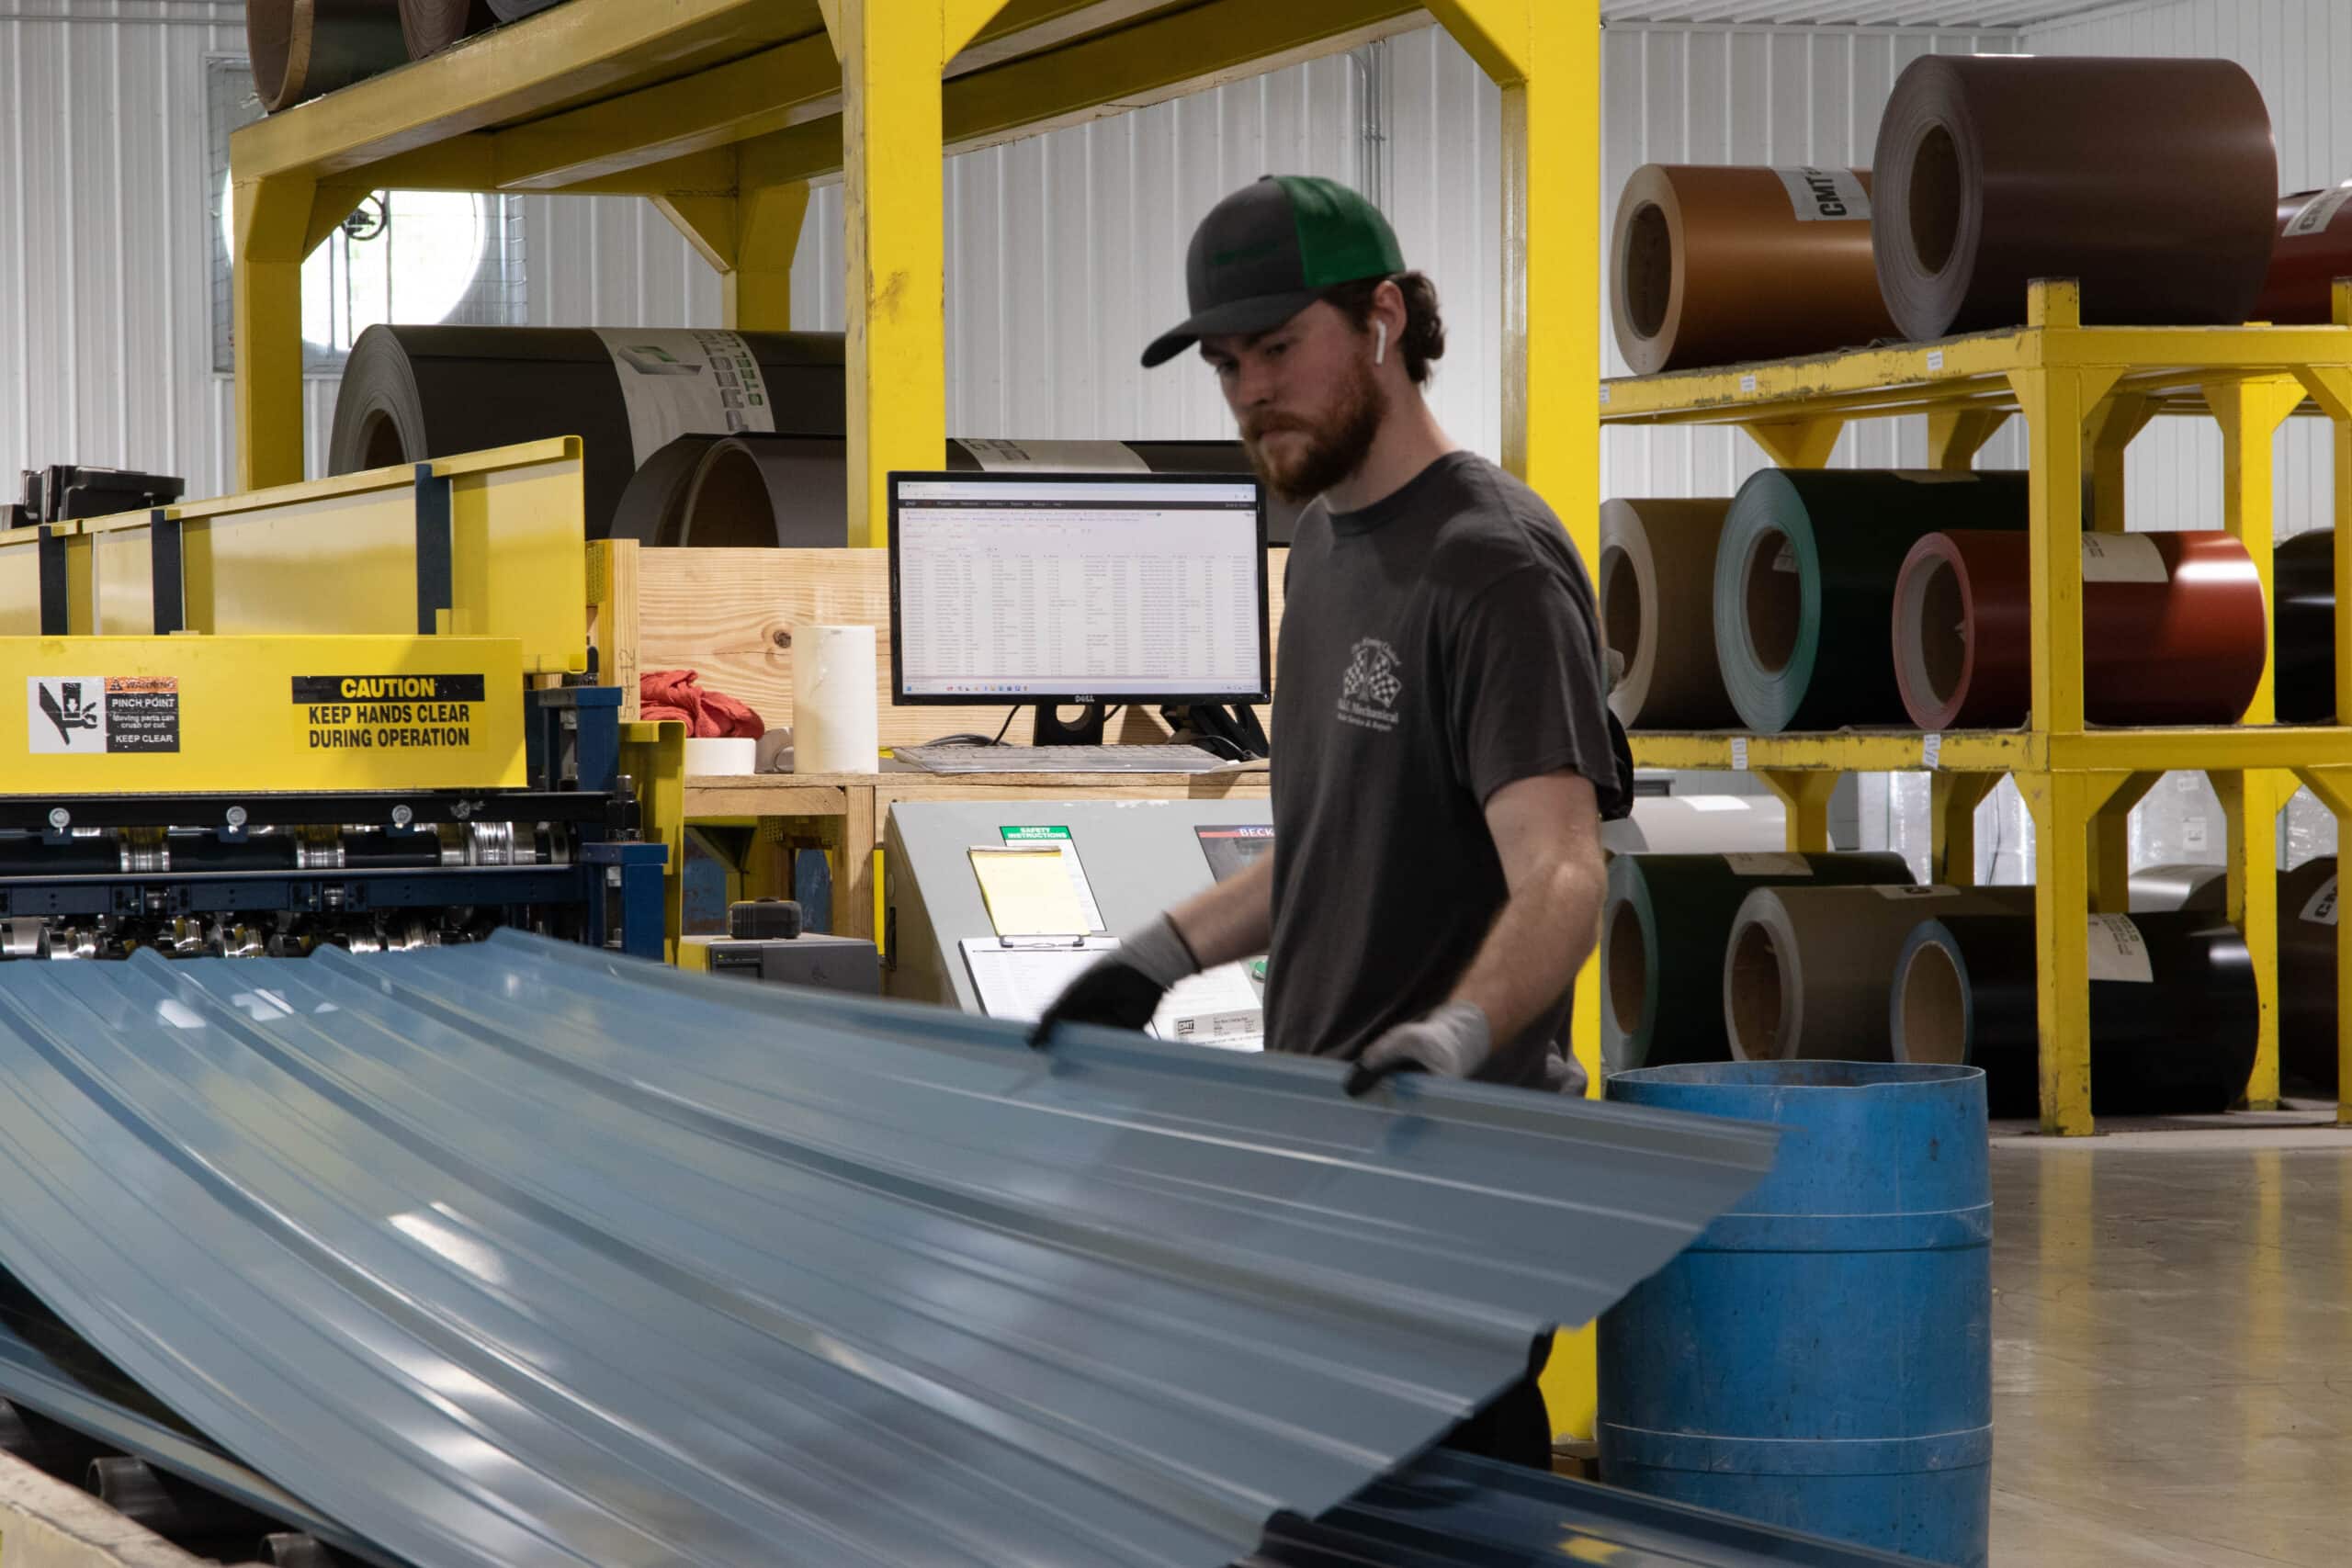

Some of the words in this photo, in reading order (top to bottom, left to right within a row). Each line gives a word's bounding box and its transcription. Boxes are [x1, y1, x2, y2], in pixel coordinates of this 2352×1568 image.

[1804, 175, 1847, 216] CMT
[340, 678, 435, 698] CAUTION
[111, 698, 142, 707] PINCH
[145, 698, 175, 707] POINT
[1075, 694, 1095, 704] DELL
[141, 715, 161, 723] parts
[309, 705, 351, 724] KEEP
[356, 705, 413, 724] HANDS
[417, 704, 470, 723] CLEAR
[116, 735, 141, 743] KEEP
[142, 735, 174, 743] CLEAR
[309, 728, 372, 749] DURING
[378, 727, 470, 747] OPERATION
